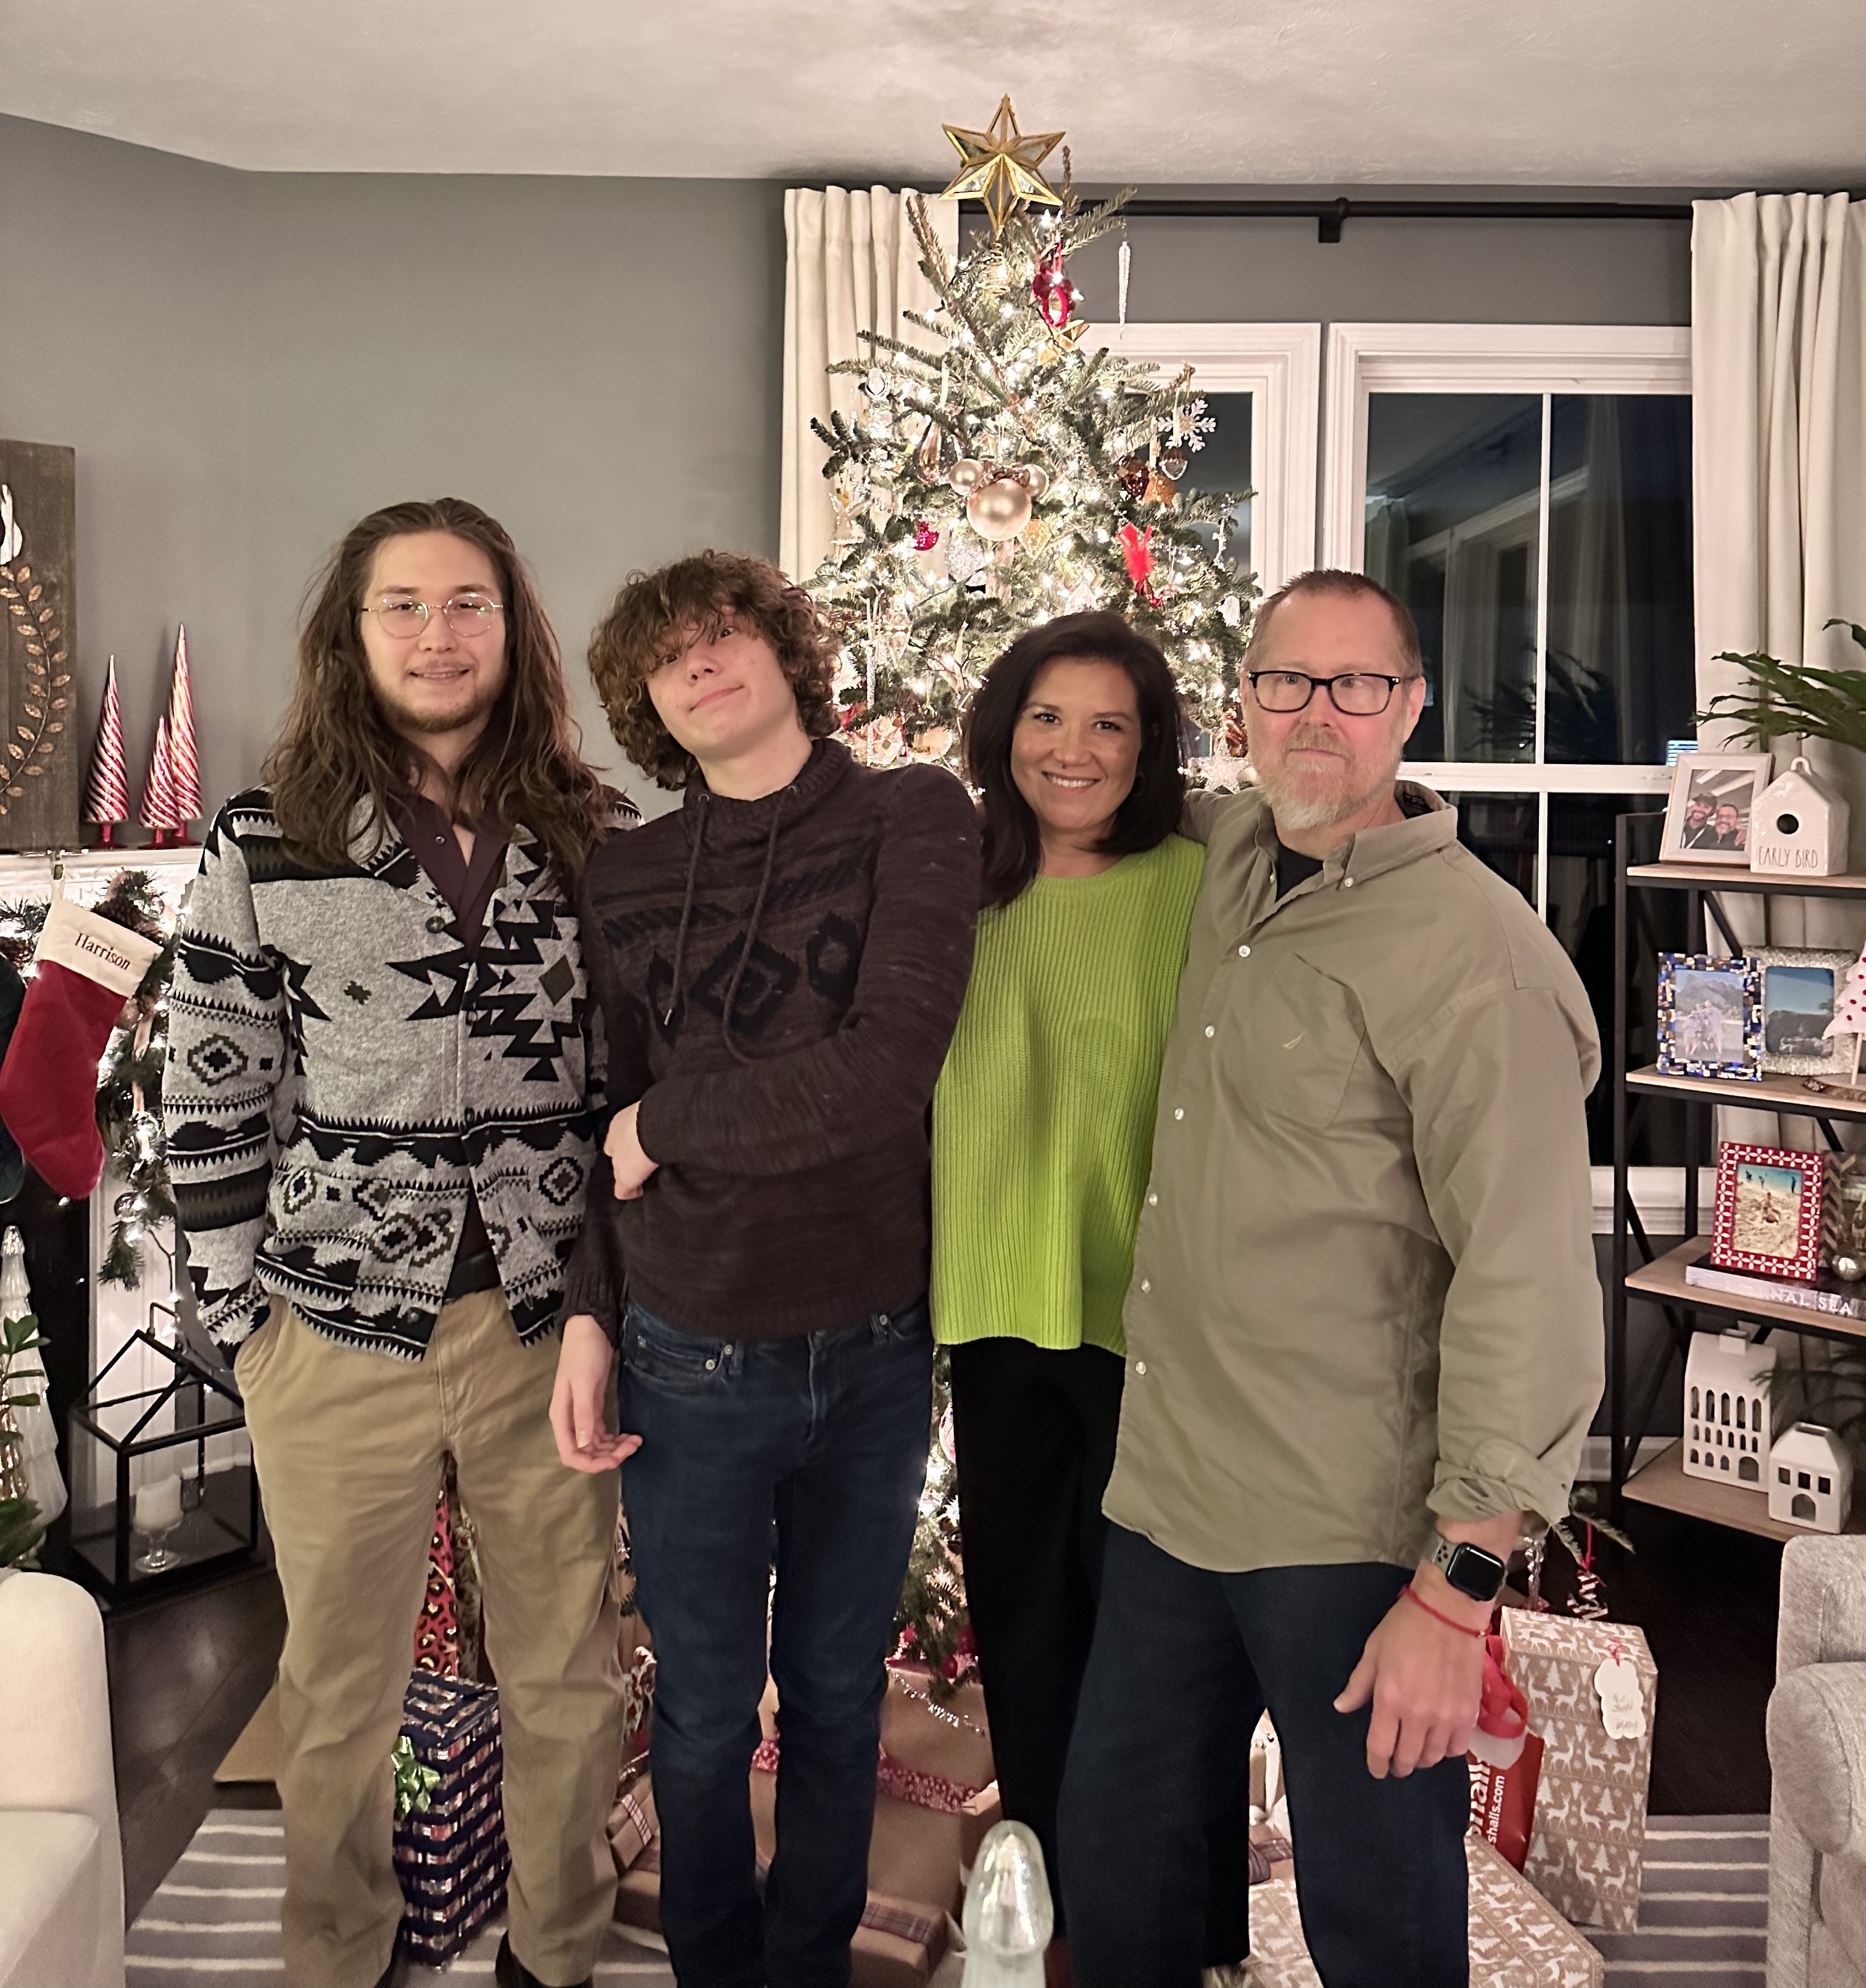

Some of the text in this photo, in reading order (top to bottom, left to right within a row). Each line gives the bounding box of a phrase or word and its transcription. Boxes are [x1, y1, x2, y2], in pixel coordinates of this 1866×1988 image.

[1759, 846, 1818, 868] EARLY BIRD
[75, 932, 131, 970] Harrison
[1818, 1296, 1852, 1316] SEA
